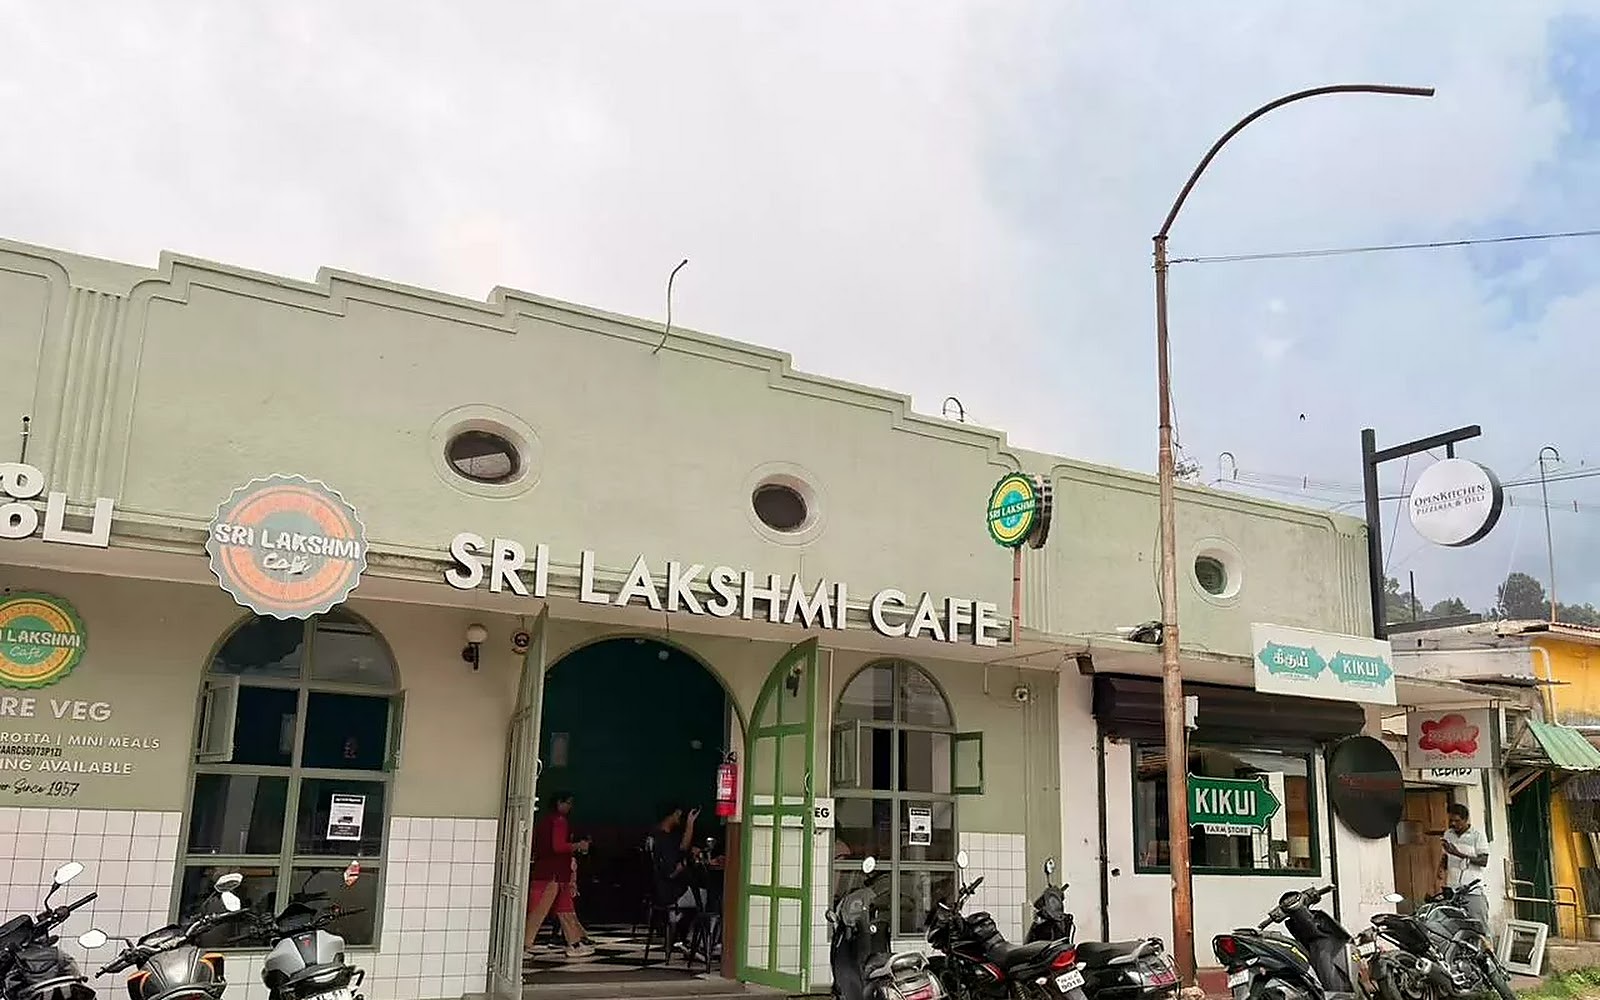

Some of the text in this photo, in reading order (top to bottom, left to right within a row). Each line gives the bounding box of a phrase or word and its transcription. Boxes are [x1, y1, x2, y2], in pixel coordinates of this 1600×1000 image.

[214, 523, 361, 560] SRI LAKSHMI
[444, 532, 998, 648] SRI LAKSHMI CAFE
[7, 629, 81, 647] LAKSHMI
[1342, 659, 1380, 677] KIKUI
[0, 696, 112, 721] RE VEG
[0, 731, 51, 745] ROTTA
[67, 735, 103, 747] MINI
[108, 737, 161, 749] MEALS
[38, 760, 133, 775] AVAILABLE
[46, 781, 80, 797] 1957
[1195, 787, 1256, 816] KIKUI
